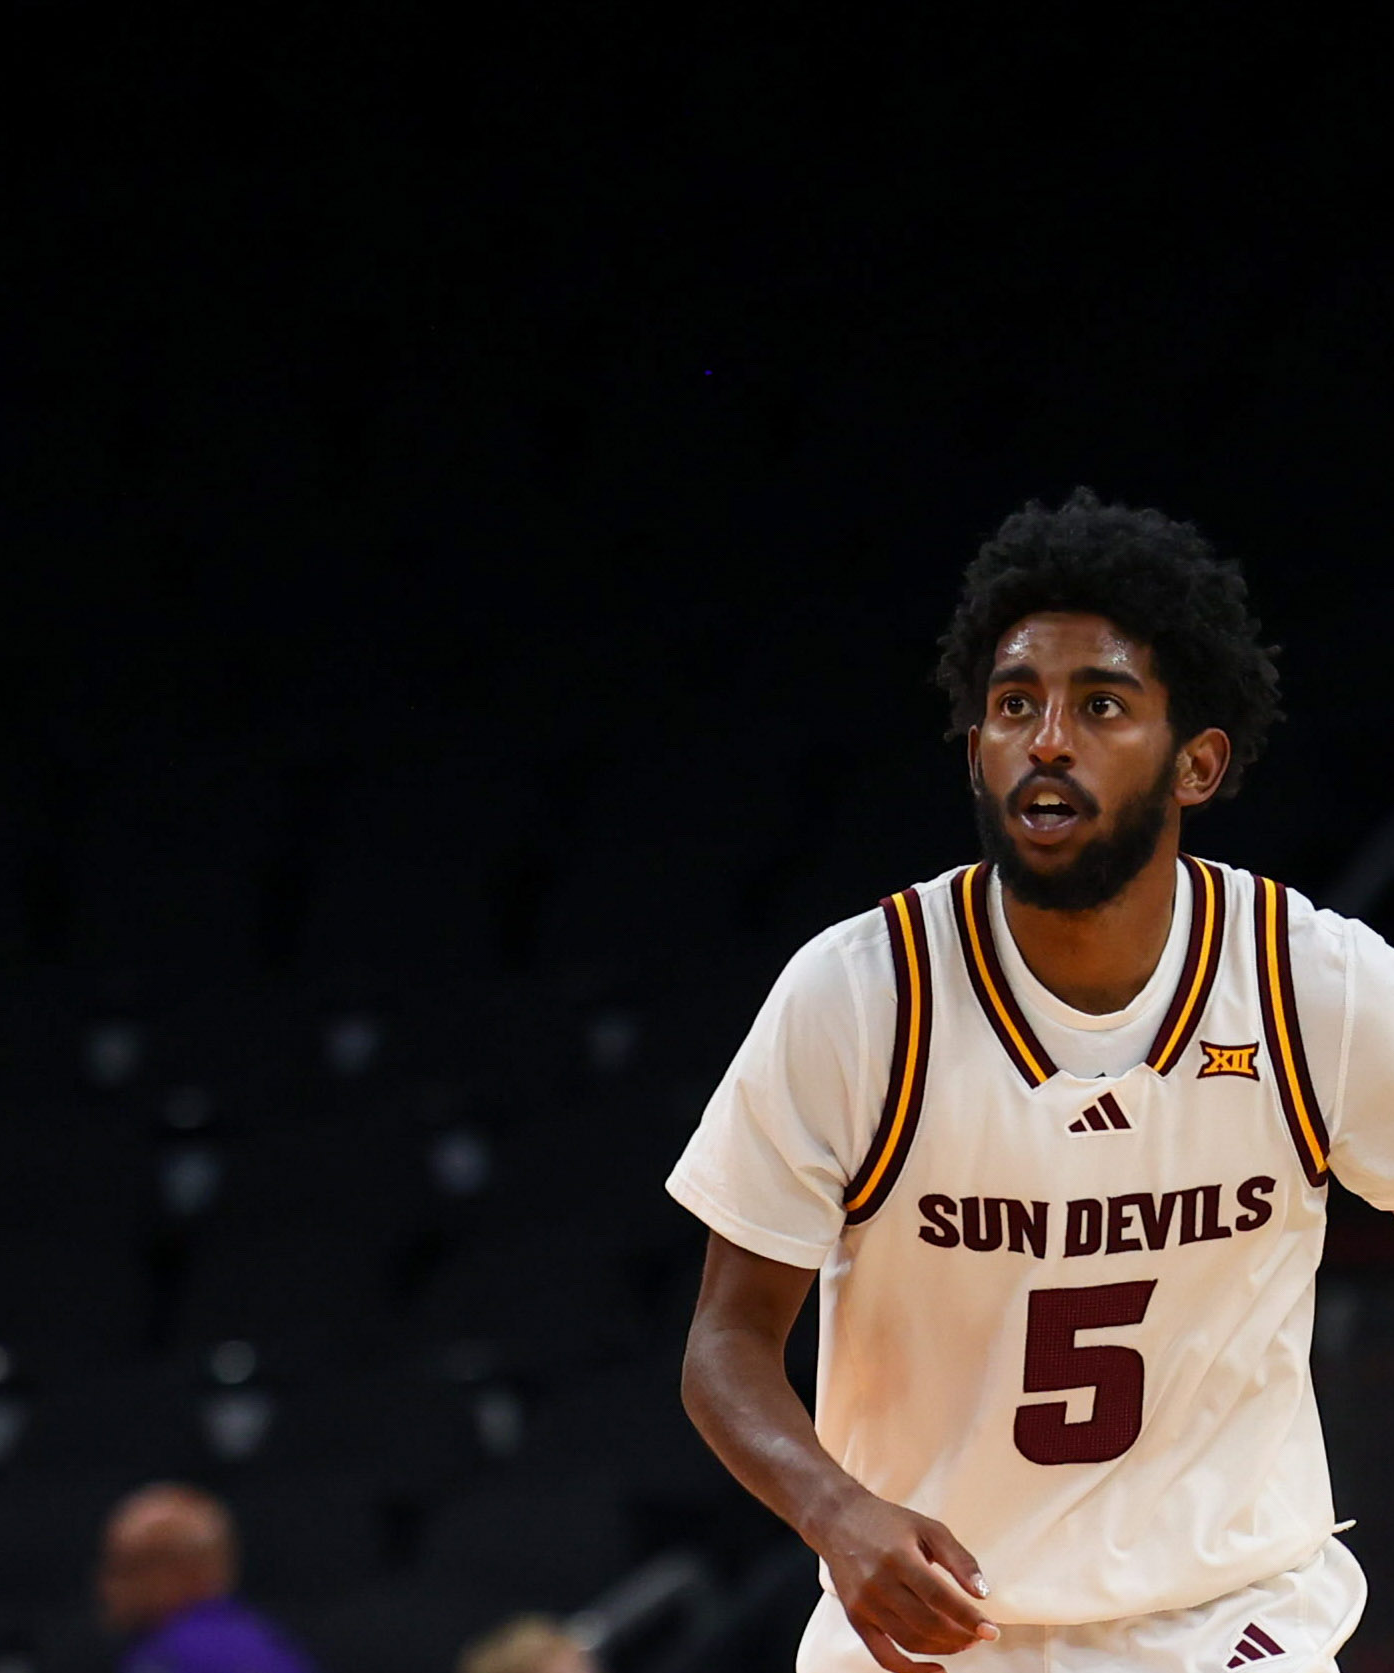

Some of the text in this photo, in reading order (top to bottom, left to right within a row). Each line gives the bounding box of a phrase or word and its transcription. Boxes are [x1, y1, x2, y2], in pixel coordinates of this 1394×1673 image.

[1200, 1045, 1258, 1077] XII
[917, 1175, 1276, 1259] SUN DEVILS
[1013, 1279, 1158, 1466] 5
